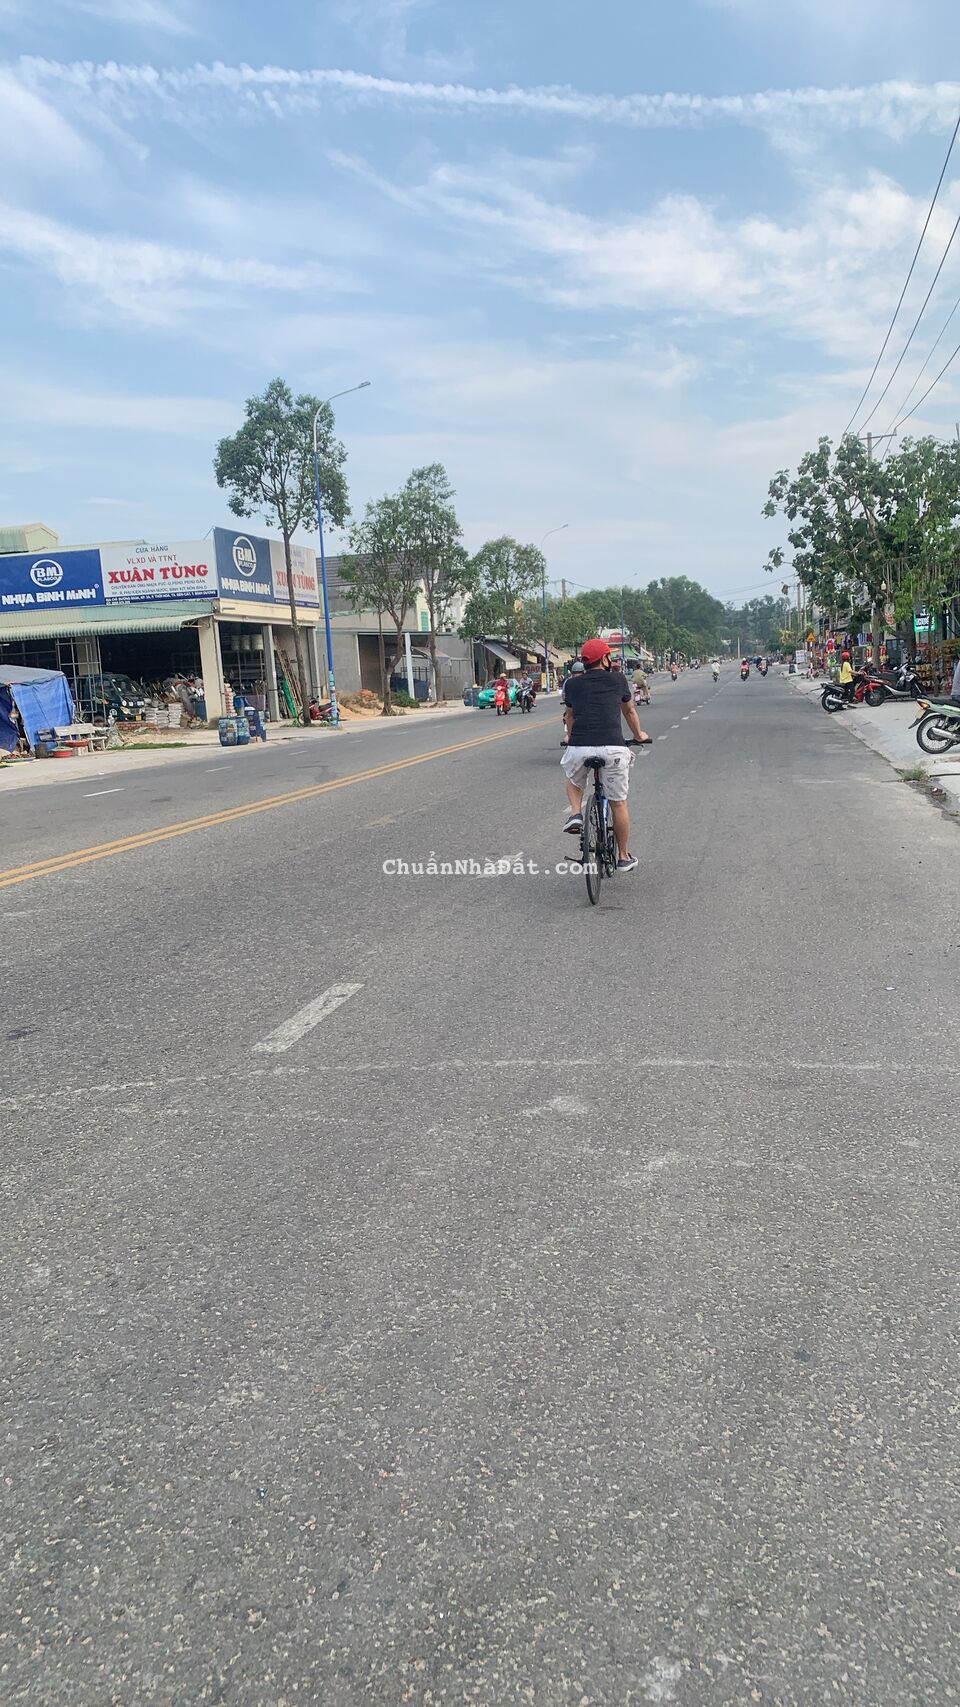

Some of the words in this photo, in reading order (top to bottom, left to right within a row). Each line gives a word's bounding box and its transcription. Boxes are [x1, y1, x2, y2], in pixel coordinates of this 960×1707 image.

[151, 544, 169, 553] HÀNG
[127, 556, 146, 564] VLXD
[148, 554, 157, 563] VÀ
[159, 553, 177, 562] TTNT
[108, 566, 155, 584] XUÂN
[160, 562, 209, 580] TÙNG
[2, 592, 35, 608] NHỰA
